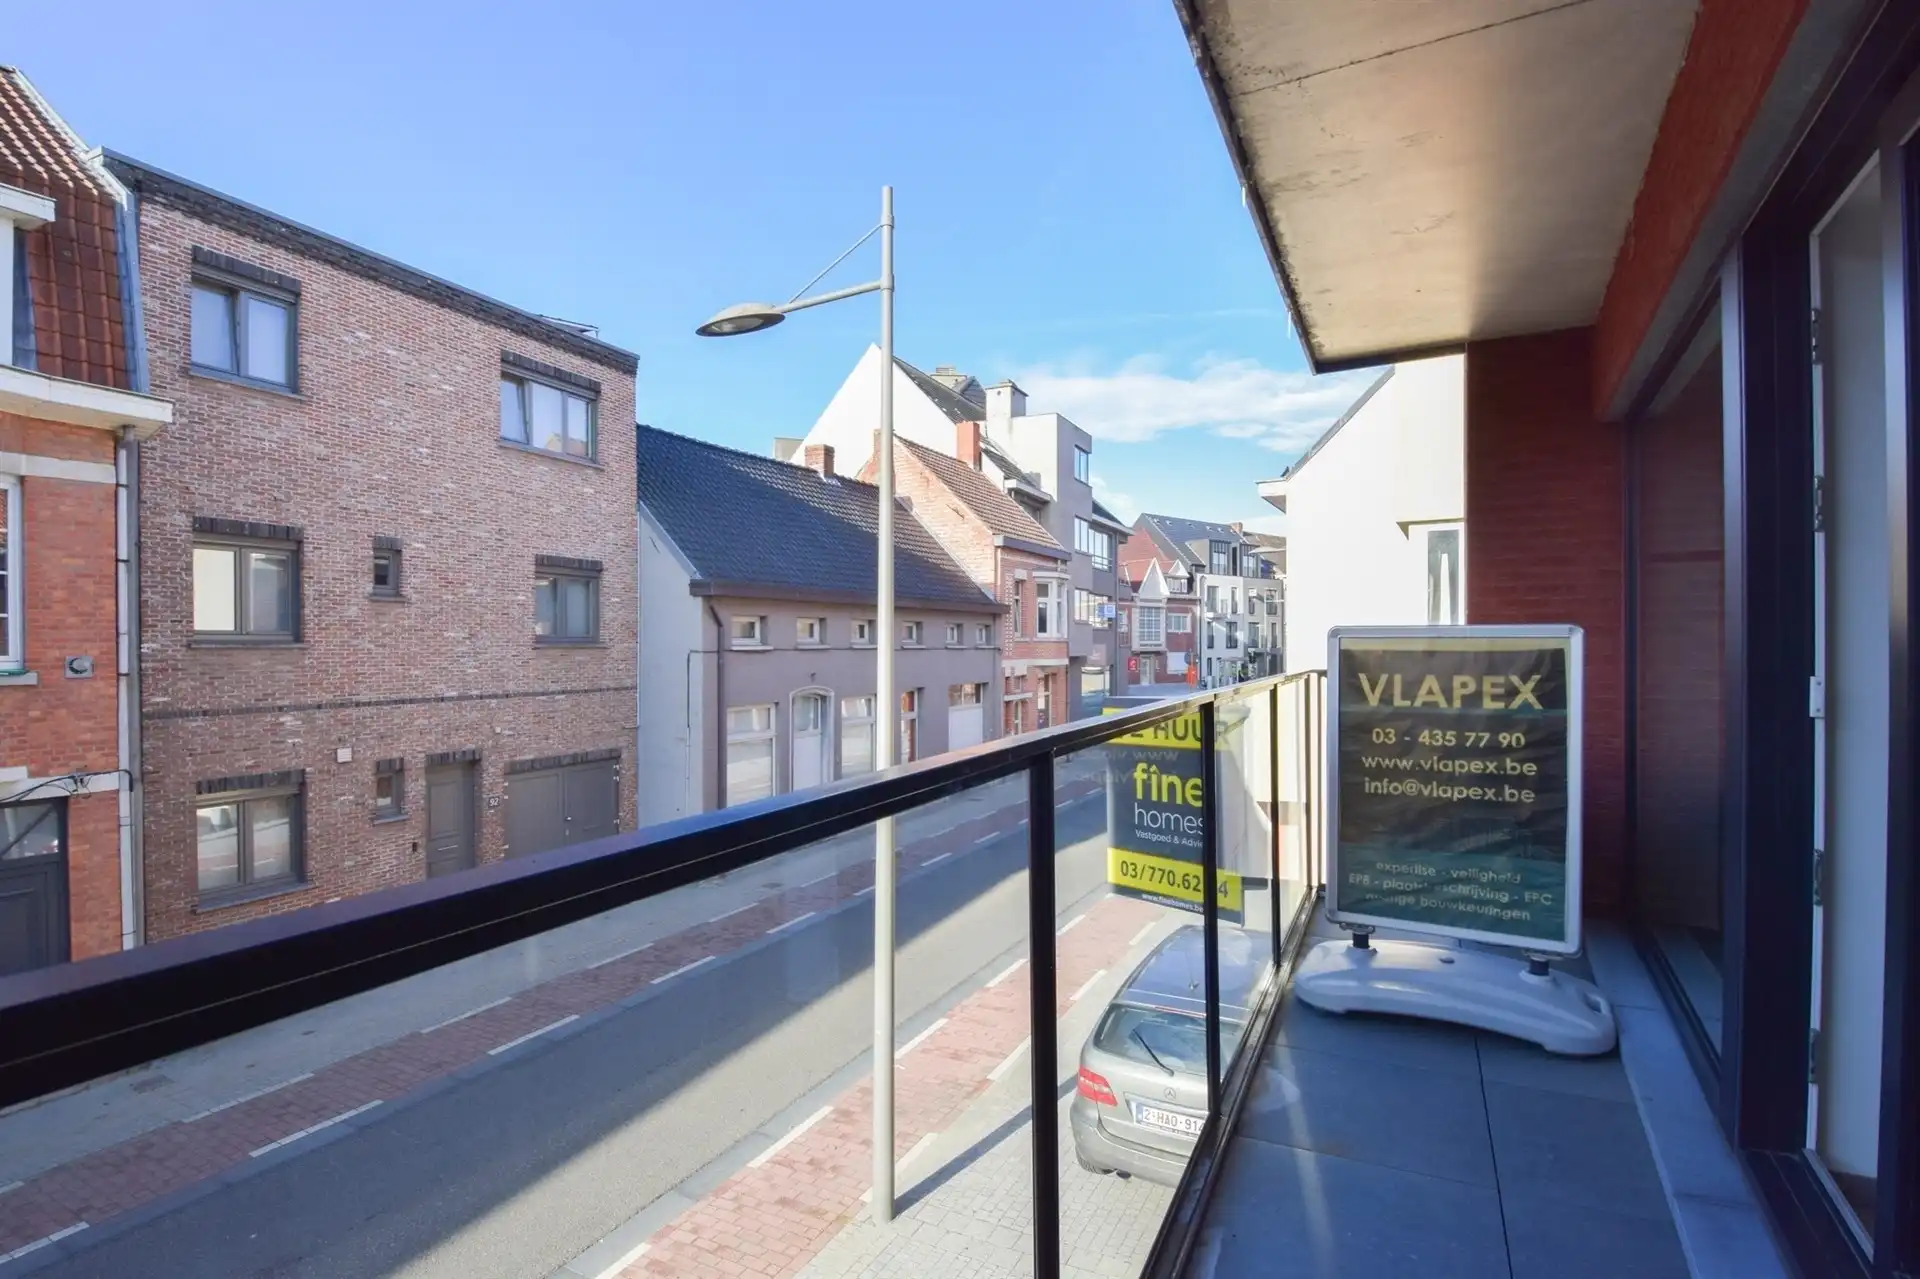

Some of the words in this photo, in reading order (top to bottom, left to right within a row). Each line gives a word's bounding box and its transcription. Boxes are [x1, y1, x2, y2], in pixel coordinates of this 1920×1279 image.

[1358, 673, 1544, 711] VLAPEX
[1371, 728, 1397, 745] 03
[1418, 729, 1457, 747] 435
[1464, 731, 1491, 749] 77
[1498, 732, 1526, 749] 90
[1361, 755, 1538, 776] www.vlapex.be
[1363, 777, 1536, 803] info@vlapex.be
[1135, 828, 1172, 843] Vastgoed
[1173, 835, 1180, 844] &
[1375, 860, 1437, 879] expertise
[1348, 873, 1370, 886] EPB
[1524, 891, 1553, 906] EPC
[1420, 895, 1531, 922] bouwkeuringen
